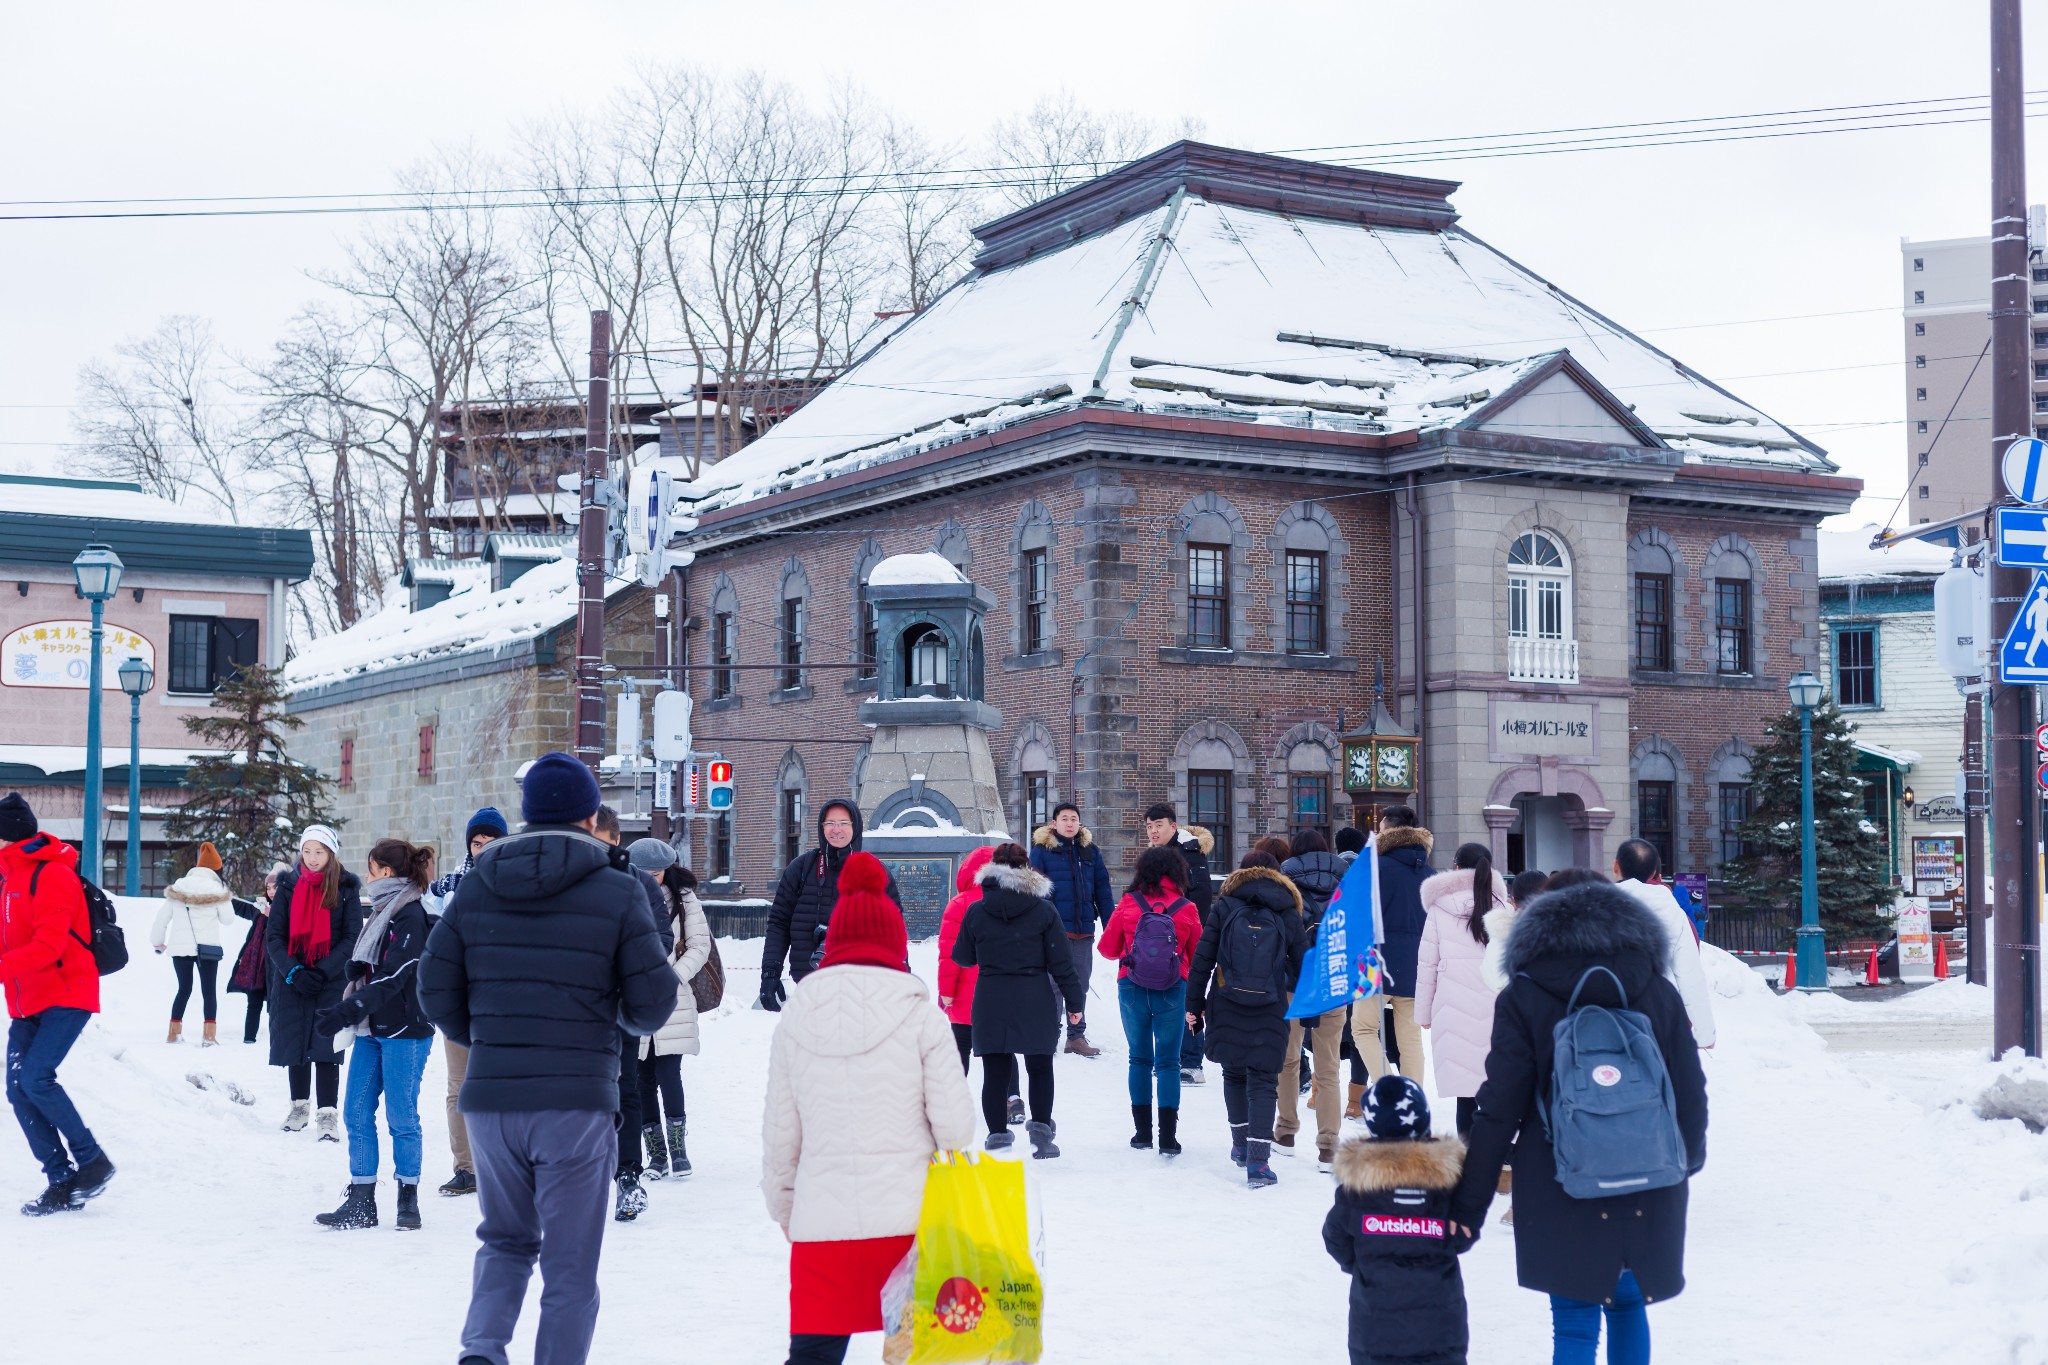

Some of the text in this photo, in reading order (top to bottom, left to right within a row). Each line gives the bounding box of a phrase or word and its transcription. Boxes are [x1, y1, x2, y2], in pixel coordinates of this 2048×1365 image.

[17, 627, 141, 651] 小樽オルル堂
[1502, 719, 1588, 737] 小樽オルゴール堂
[1327, 909, 1348, 997] 全景旅游
[1365, 1217, 1443, 1236] Outside Life
[996, 1298, 1037, 1311] Tax-free
[1013, 1314, 1038, 1329] Shop
